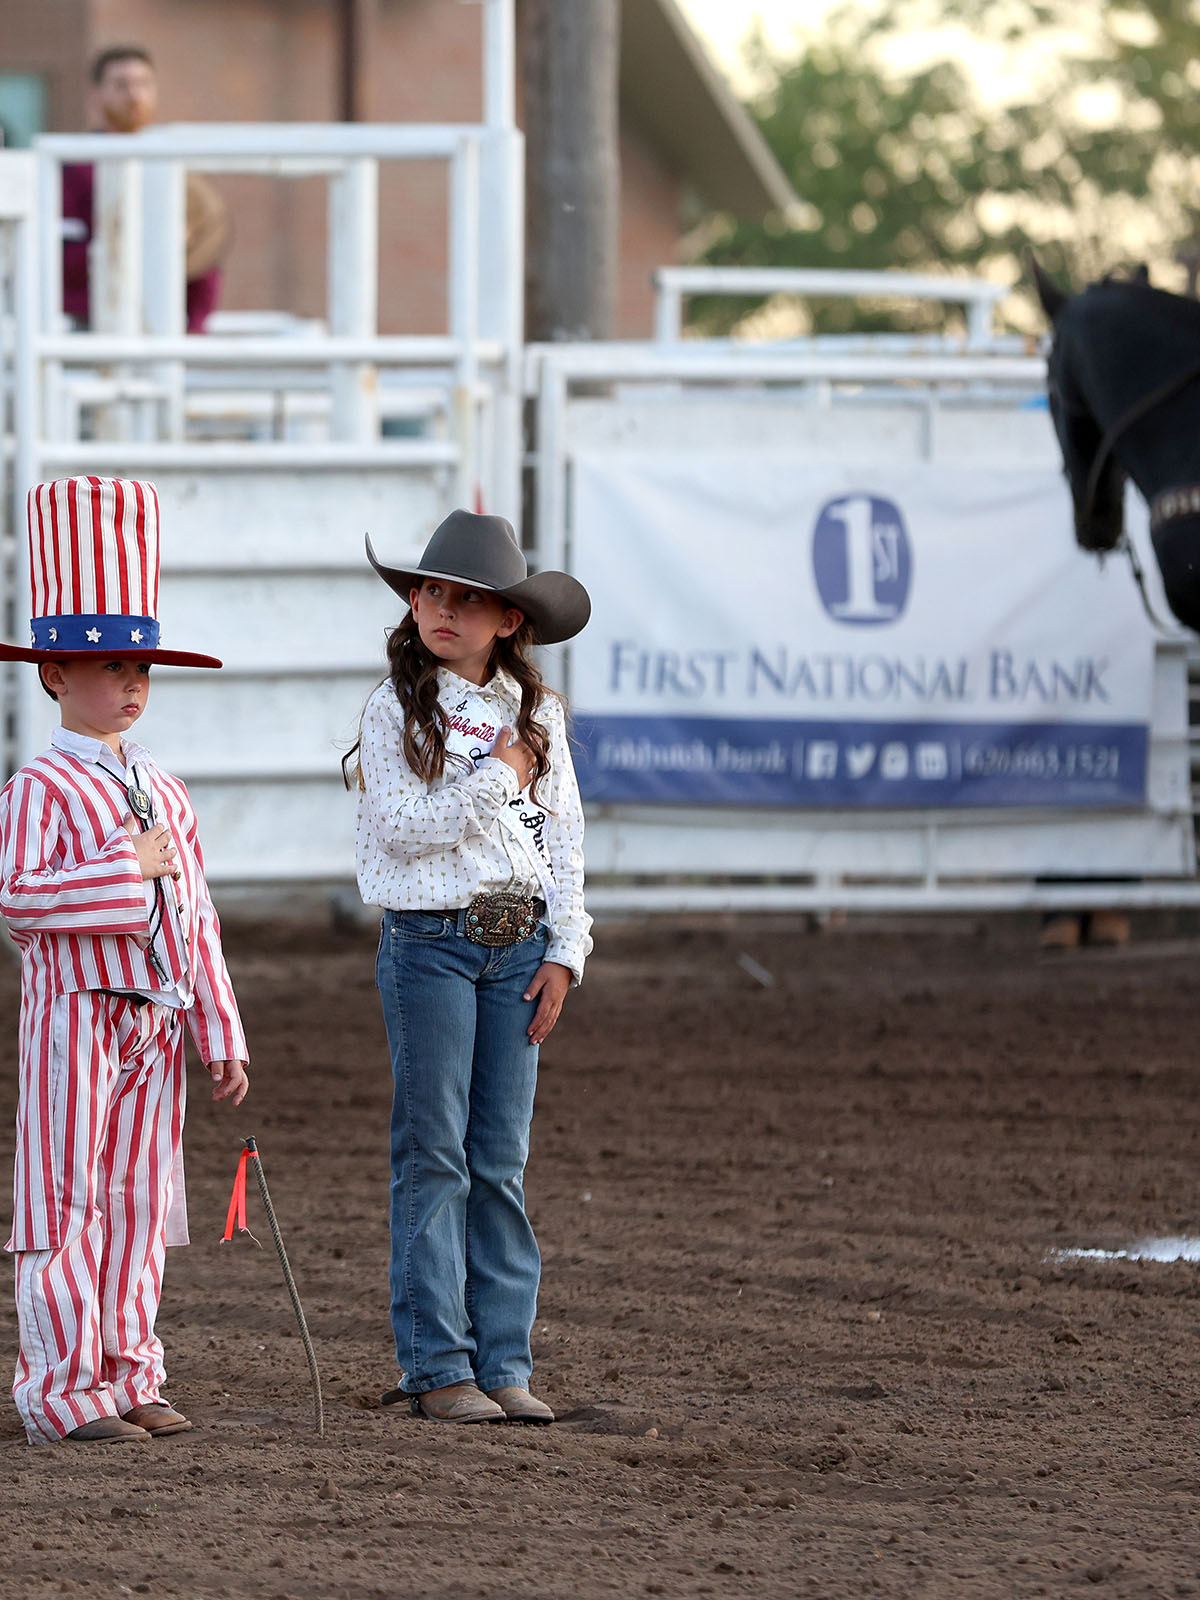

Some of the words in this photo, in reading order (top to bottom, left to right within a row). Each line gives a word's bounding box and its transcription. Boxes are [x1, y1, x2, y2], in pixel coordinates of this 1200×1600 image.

[608, 640, 739, 698] FIRST
[746, 643, 973, 702] NATIONAL
[989, 646, 1110, 704] BANK
